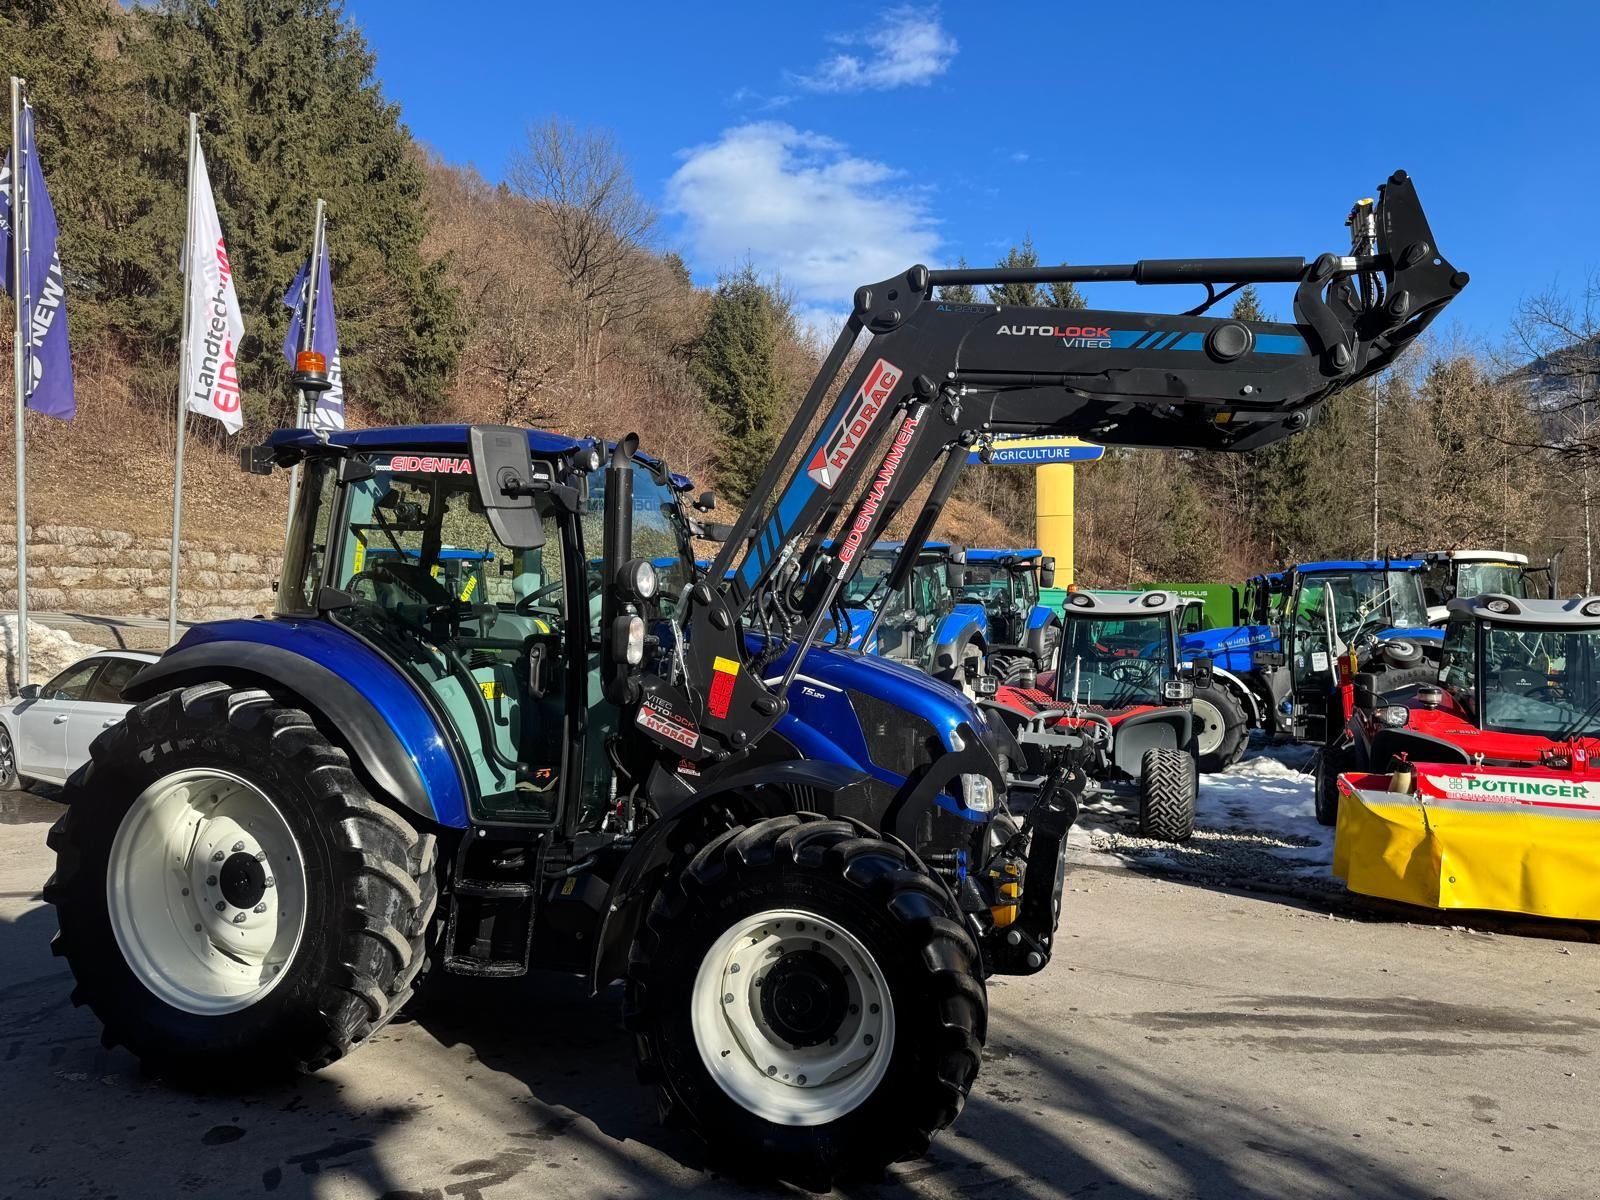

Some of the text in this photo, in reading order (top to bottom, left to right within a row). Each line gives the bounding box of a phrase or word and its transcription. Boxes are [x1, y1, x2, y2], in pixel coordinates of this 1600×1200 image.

[32, 276, 64, 348] NEW
[996, 325, 1112, 338] AUTOLOCK
[831, 372, 897, 469] HYDRAC
[992, 448, 1071, 461] AGRICULTURE
[643, 700, 695, 729] AUTOLOCK
[646, 717, 695, 747] HYDRAC
